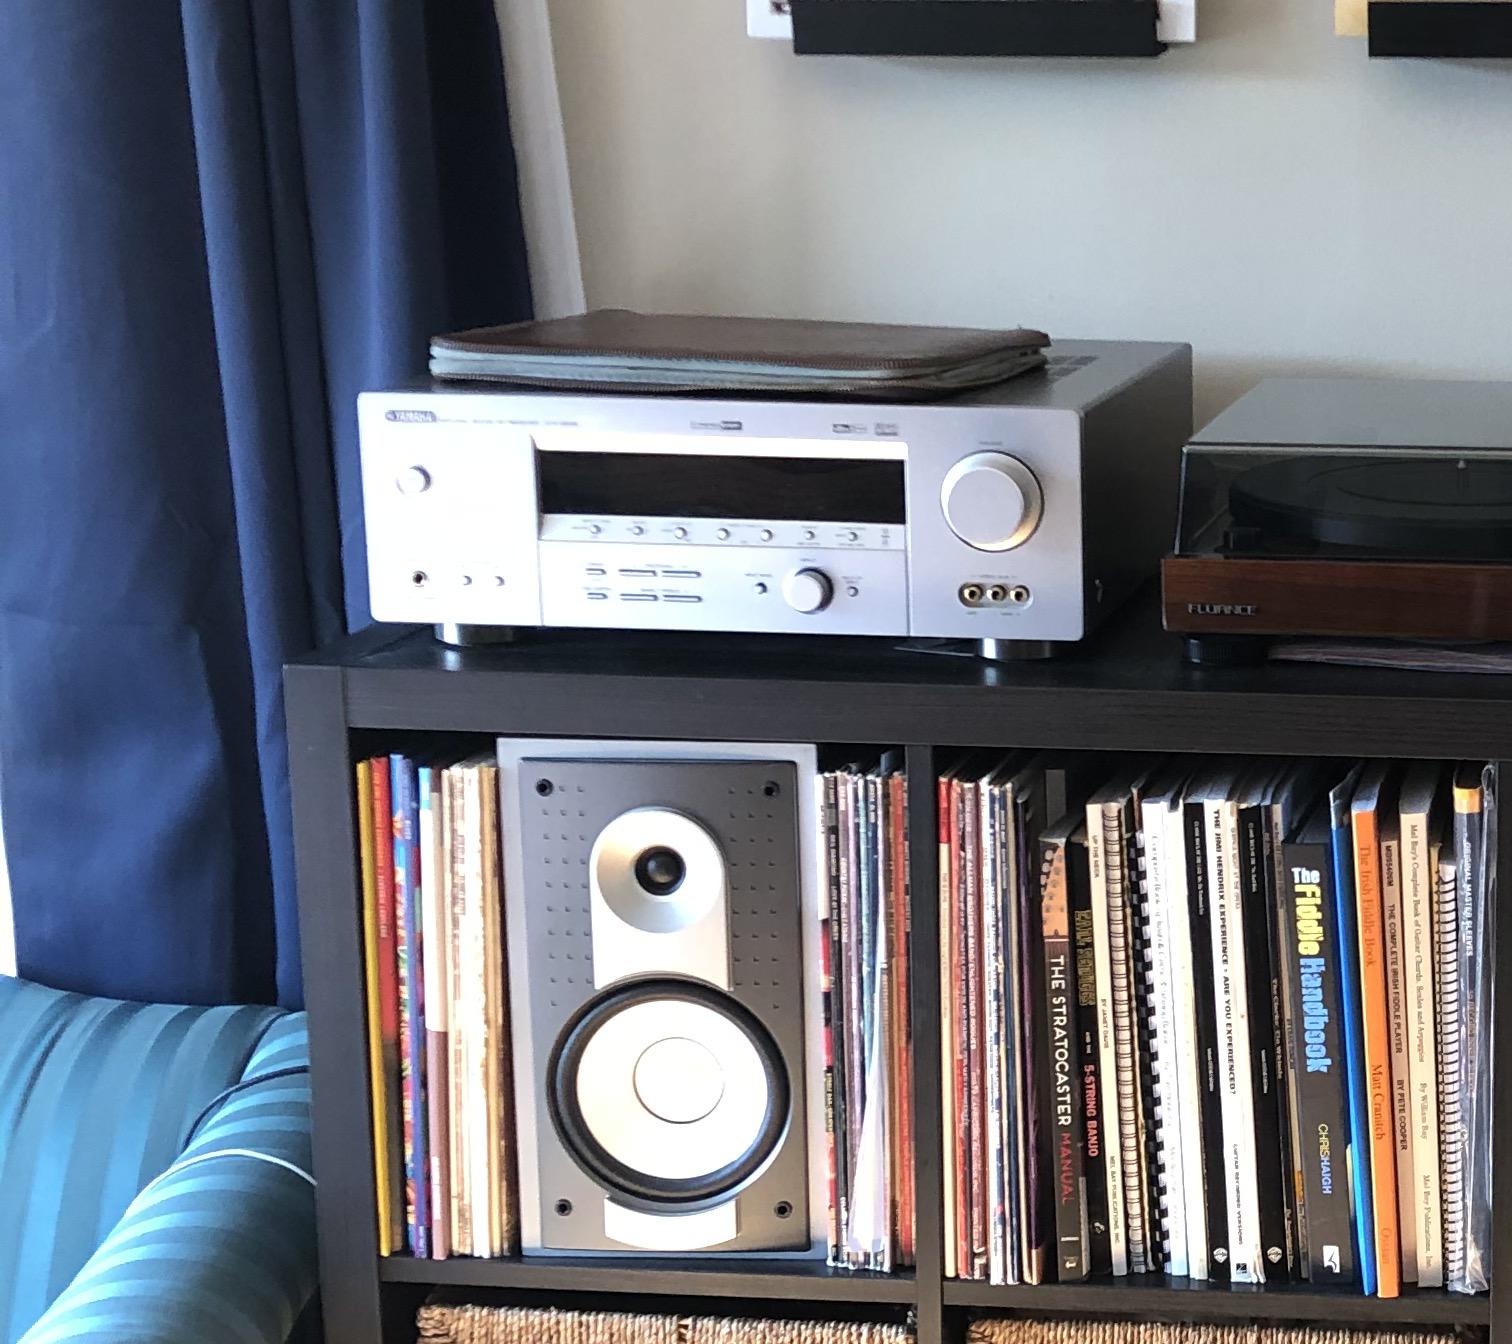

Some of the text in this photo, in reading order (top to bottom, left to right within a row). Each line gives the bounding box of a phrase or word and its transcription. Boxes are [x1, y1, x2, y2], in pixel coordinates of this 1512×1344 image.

[1411, 824, 1419, 838] Mel
[1361, 845, 1377, 968] The Irish Fiddle Book
[1410, 862, 1421, 898] Complete
[1463, 842, 1474, 956] ORIGINAL MASTER SLEEVES
[1413, 900, 1422, 918] Book
[1414, 919, 1422, 928] of
[1074, 909, 1096, 1006] EARL SCRUGGS
[1213, 809, 1237, 1094] THE JIMI HENDRIX EXPERIENCE ARE YOU EXPERIENCED?
[1291, 867, 1333, 1073] The Fiddle Handbook
[1388, 904, 1403, 1053] THE COMPLETE IRISH FIDDLE PLAYER
[1416, 985, 1425, 1009] Scales
[1417, 1011, 1425, 1024] and
[1050, 956, 1076, 1206] THE STRATOCASTER MANUAL
[1084, 1064, 1097, 1117] 5-STRING
[1372, 1064, 1386, 1140] Matt Cranitch
[1087, 1120, 1099, 1157] BANJO
[1397, 1080, 1408, 1151] BY PETE COOPER
[1419, 1083, 1429, 1140] By William Bay
[1422, 1174, 1431, 1189] Mel
